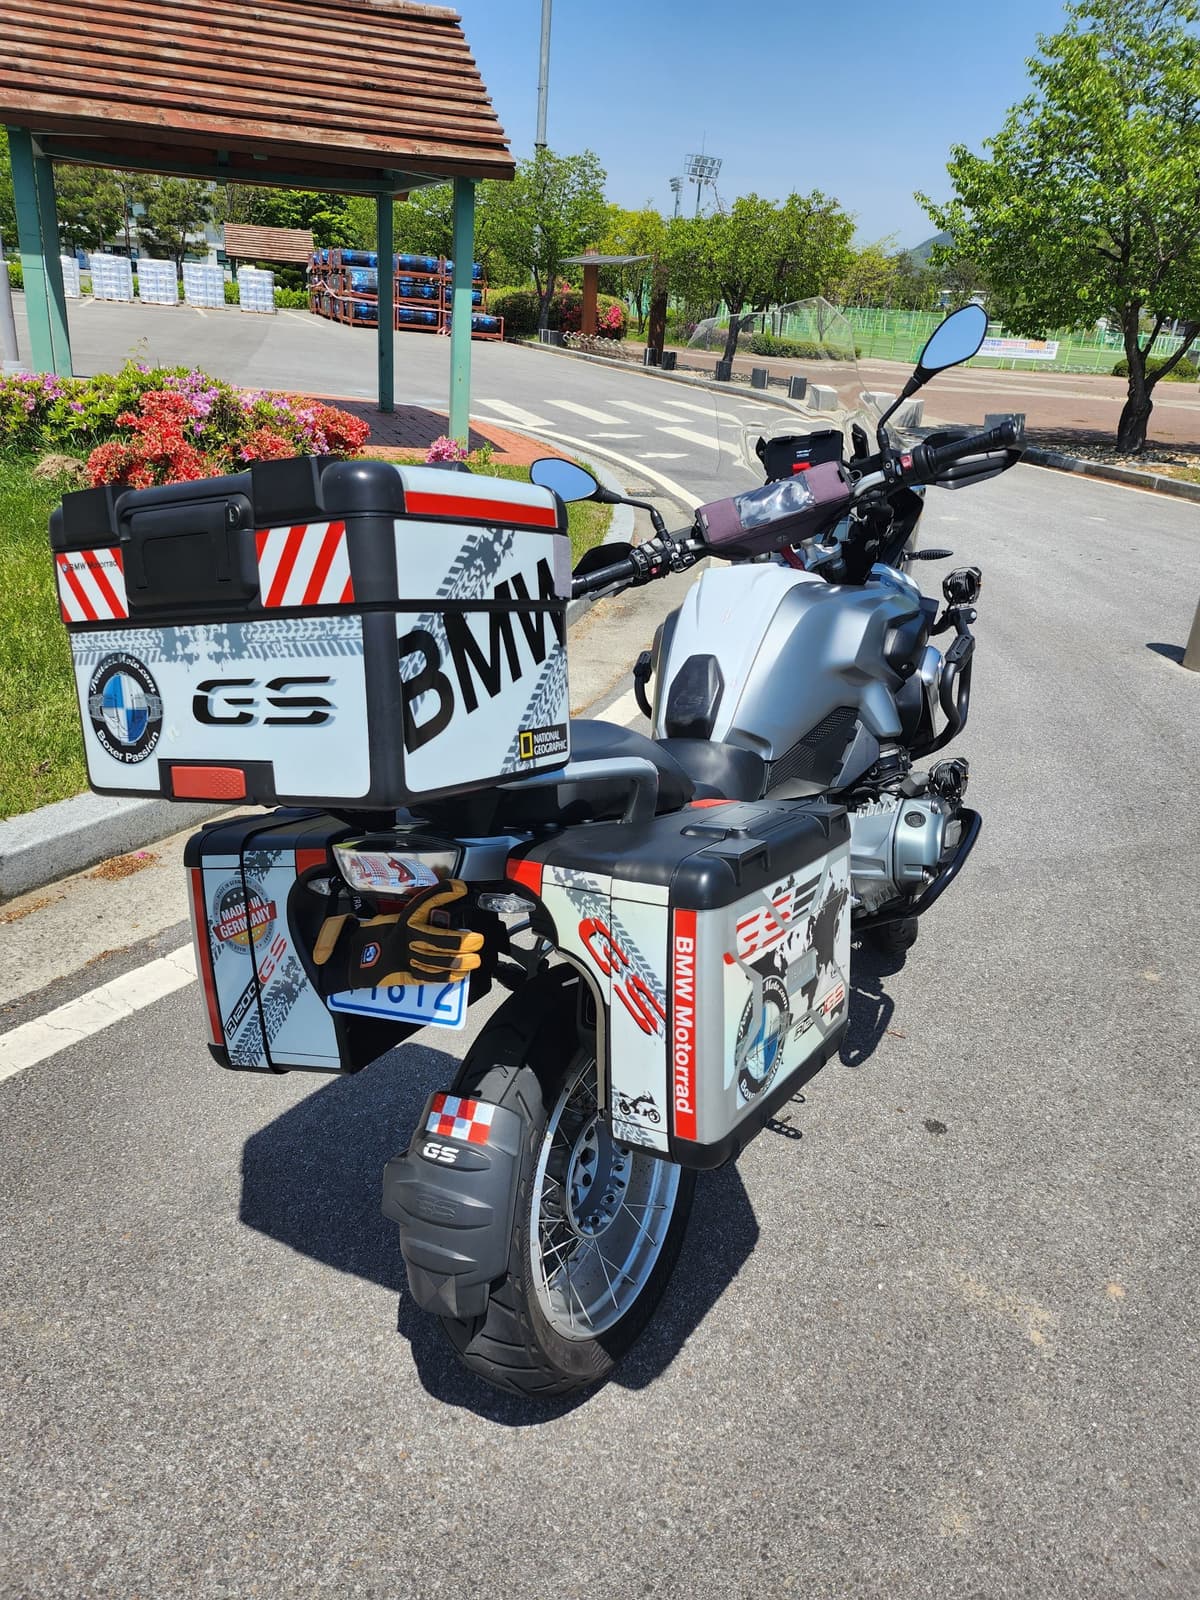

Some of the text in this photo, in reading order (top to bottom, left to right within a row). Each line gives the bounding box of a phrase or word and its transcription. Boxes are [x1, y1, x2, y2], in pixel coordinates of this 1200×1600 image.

[398, 558, 568, 754] BMW
[192, 676, 335, 726] GS
[96, 729, 159, 763] Boxer Passion
[534, 730, 560, 745] NATIONAL
[534, 739, 567, 756] GEOGRAPHIC
[219, 906, 271, 939] GERMANY
[220, 896, 262, 922] MADE IN
[578, 916, 667, 1037] GS
[674, 936, 695, 1115] BMW Motorrad
[422, 1142, 460, 1163] GS
